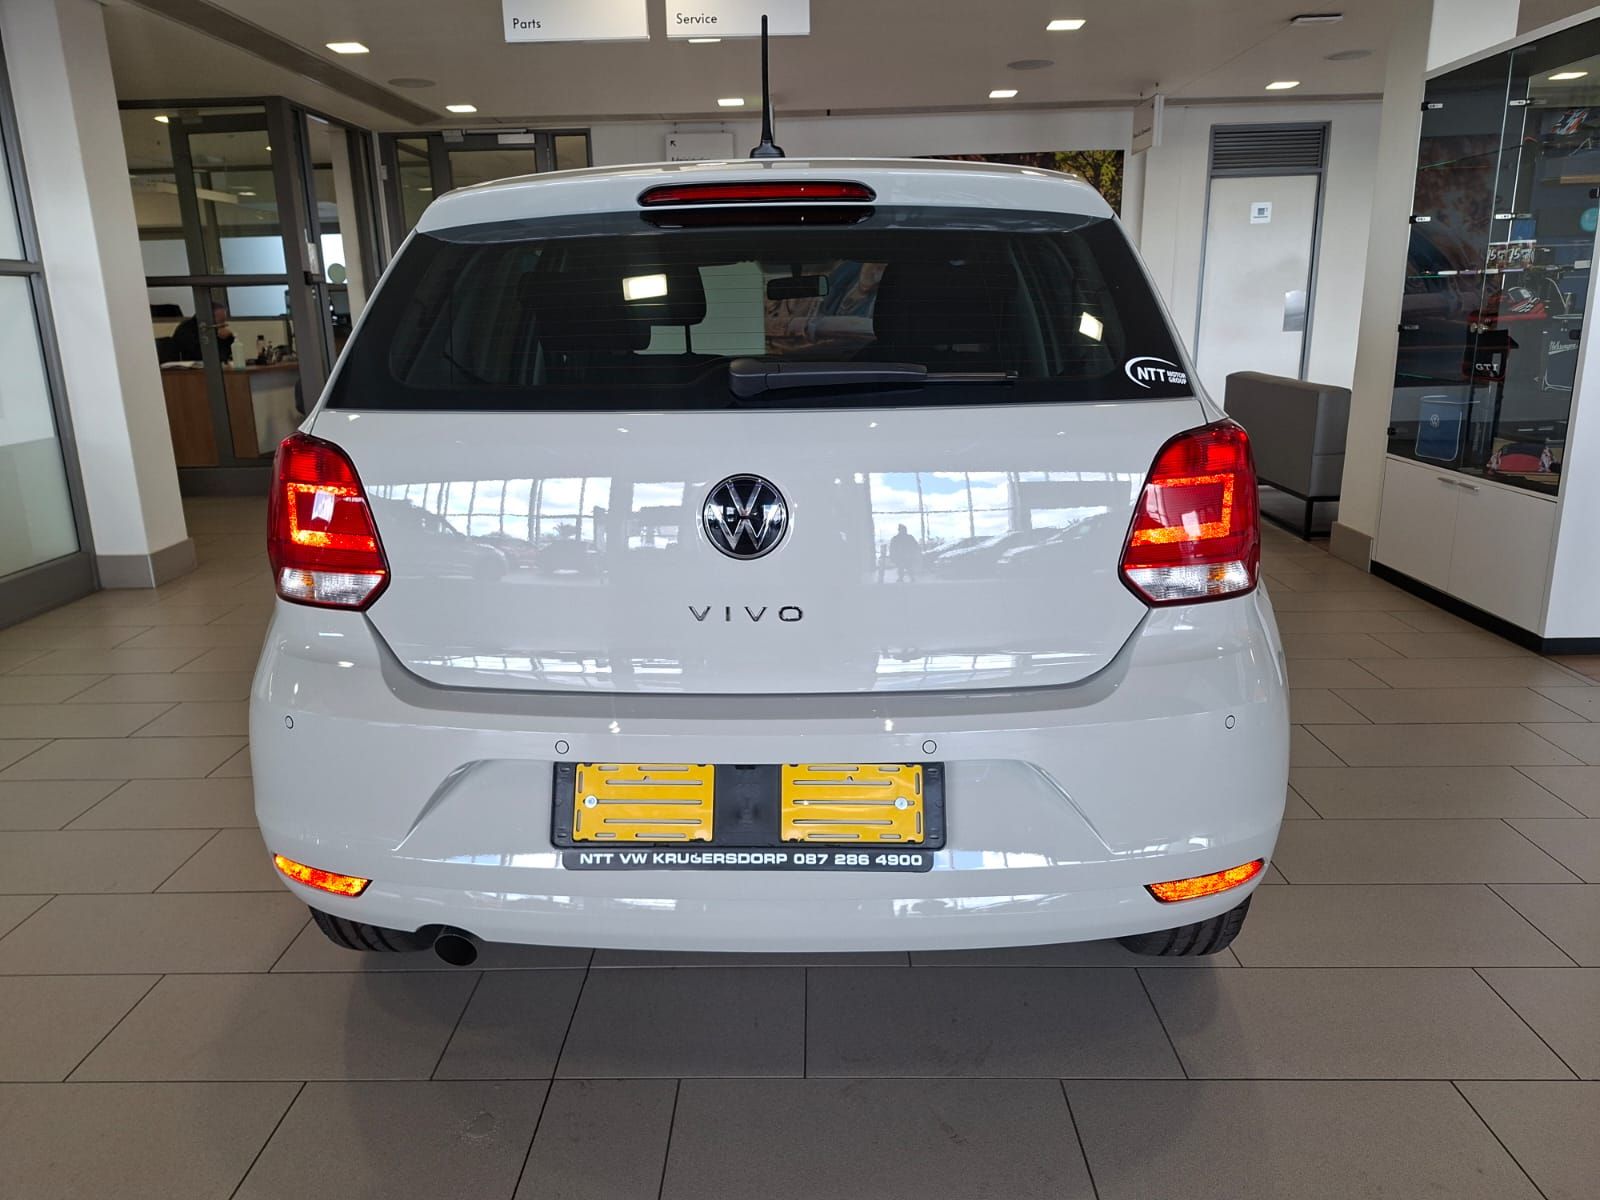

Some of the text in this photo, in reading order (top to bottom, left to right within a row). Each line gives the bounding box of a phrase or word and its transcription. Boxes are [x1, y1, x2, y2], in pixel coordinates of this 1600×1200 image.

[512, 17, 542, 29] Parts
[676, 13, 718, 24] Service
[1475, 363, 1499, 371] GTI
[1136, 366, 1166, 382] NTT
[688, 605, 804, 622] VIVO
[579, 852, 923, 866] NTT VW KRUGERSDORP 087 286 4900
